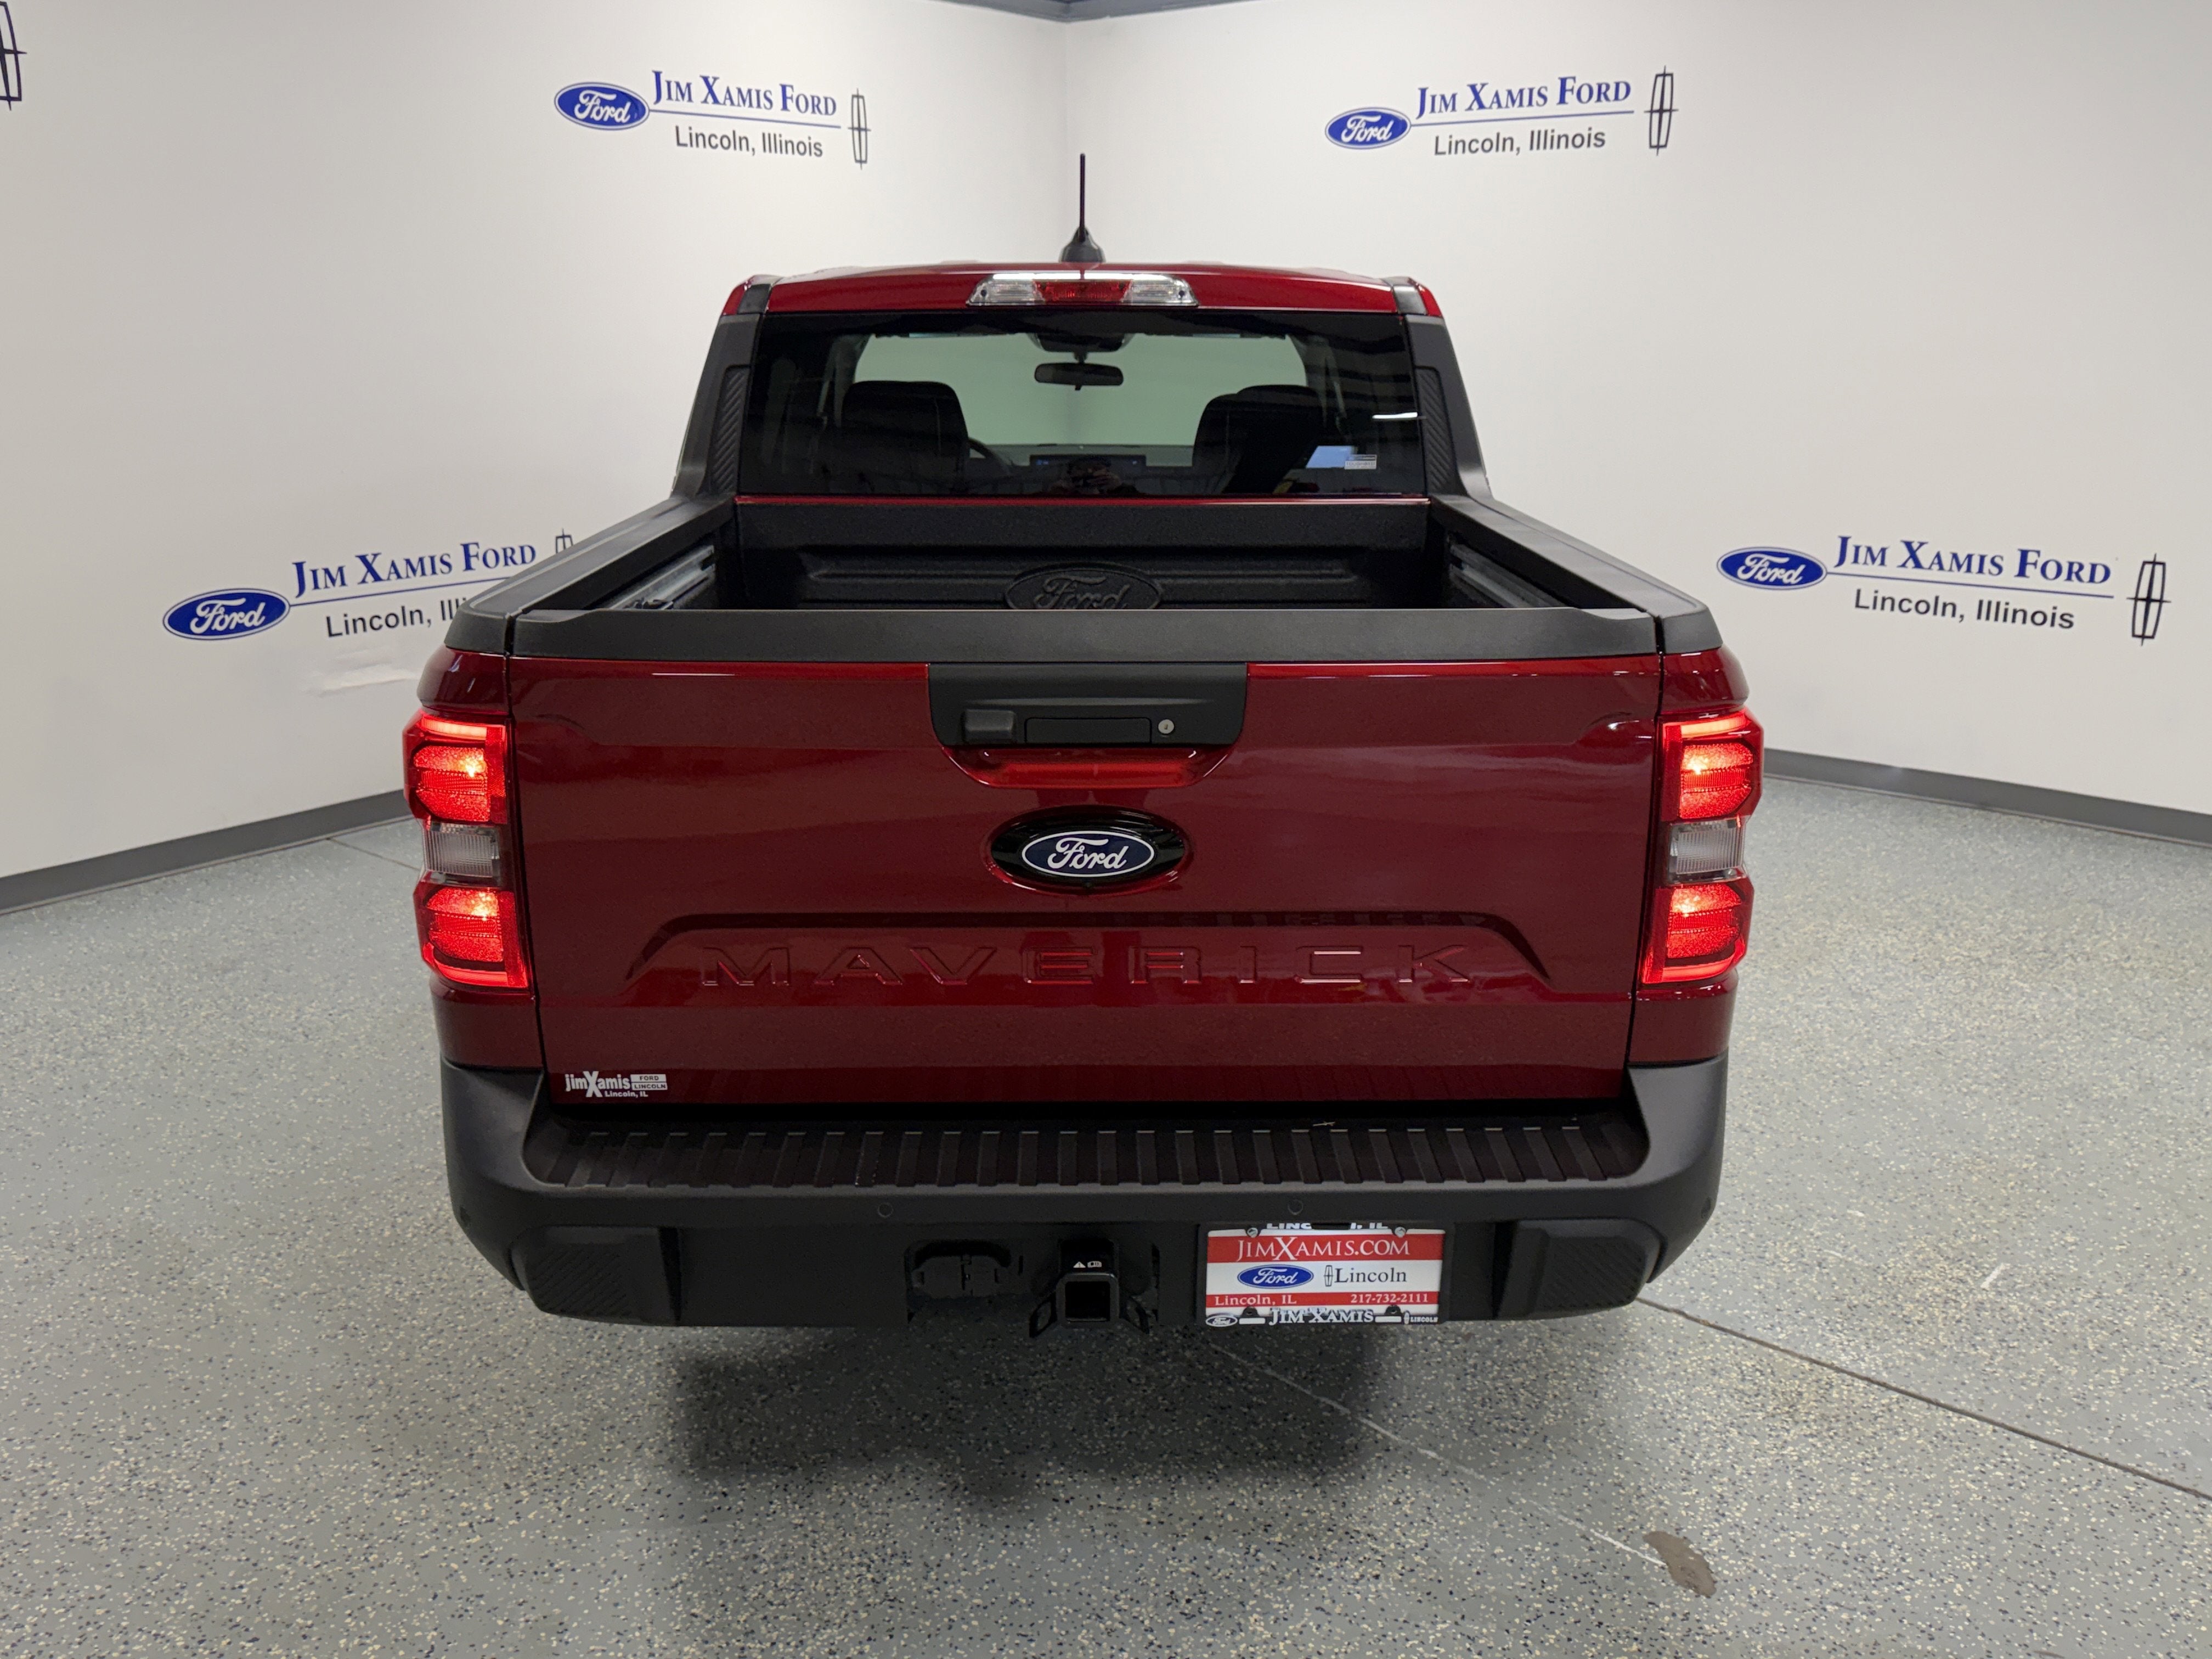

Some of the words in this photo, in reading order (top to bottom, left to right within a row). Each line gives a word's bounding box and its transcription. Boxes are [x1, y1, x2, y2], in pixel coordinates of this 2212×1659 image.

[574, 89, 630, 123] Ford
[652, 70, 692, 105] JIM
[699, 75, 774, 110] XAMIS
[779, 83, 837, 116] FORD
[1415, 87, 1458, 120] JIM
[1465, 82, 1548, 112] XAMIS
[1556, 76, 1631, 105] FORD
[675, 126, 755, 156] Lincoln,
[763, 132, 823, 157] Illinois
[1340, 115, 1393, 142] Ford
[1434, 132, 1521, 156] Lincoln,
[1529, 127, 1606, 151] Illinois
[292, 561, 348, 599] JIM
[355, 552, 453, 585] XAMIS
[460, 542, 536, 572] FORD
[1736, 554, 1804, 586] Ford
[1833, 535, 1889, 568] JIM
[1897, 539, 2004, 577] XAMIS
[2014, 549, 2111, 585] FORD
[1034, 575, 1130, 609] Ford
[189, 598, 266, 634] Ford
[325, 604, 432, 637] Lincoln,
[1854, 588, 1965, 622] Lincoln,
[1977, 599, 2075, 630] Illinois
[1047, 837, 1129, 869] Ford
[702, 945, 1469, 986] MAVERICK
[1236, 1237, 1410, 1262] JIMXAMIS.COM
[1253, 1268, 1299, 1284] Ford
[1334, 1268, 1407, 1283] Lincoln
[1215, 1295, 1276, 1305] Lincoln,
[1282, 1295, 1297, 1304] IL
[1351, 1294, 1428, 1303] 217-732-2111
[1212, 1317, 1231, 1325] Ford
[1268, 1308, 1305, 1325] JIM
[1308, 1307, 1374, 1323] XAMIS
